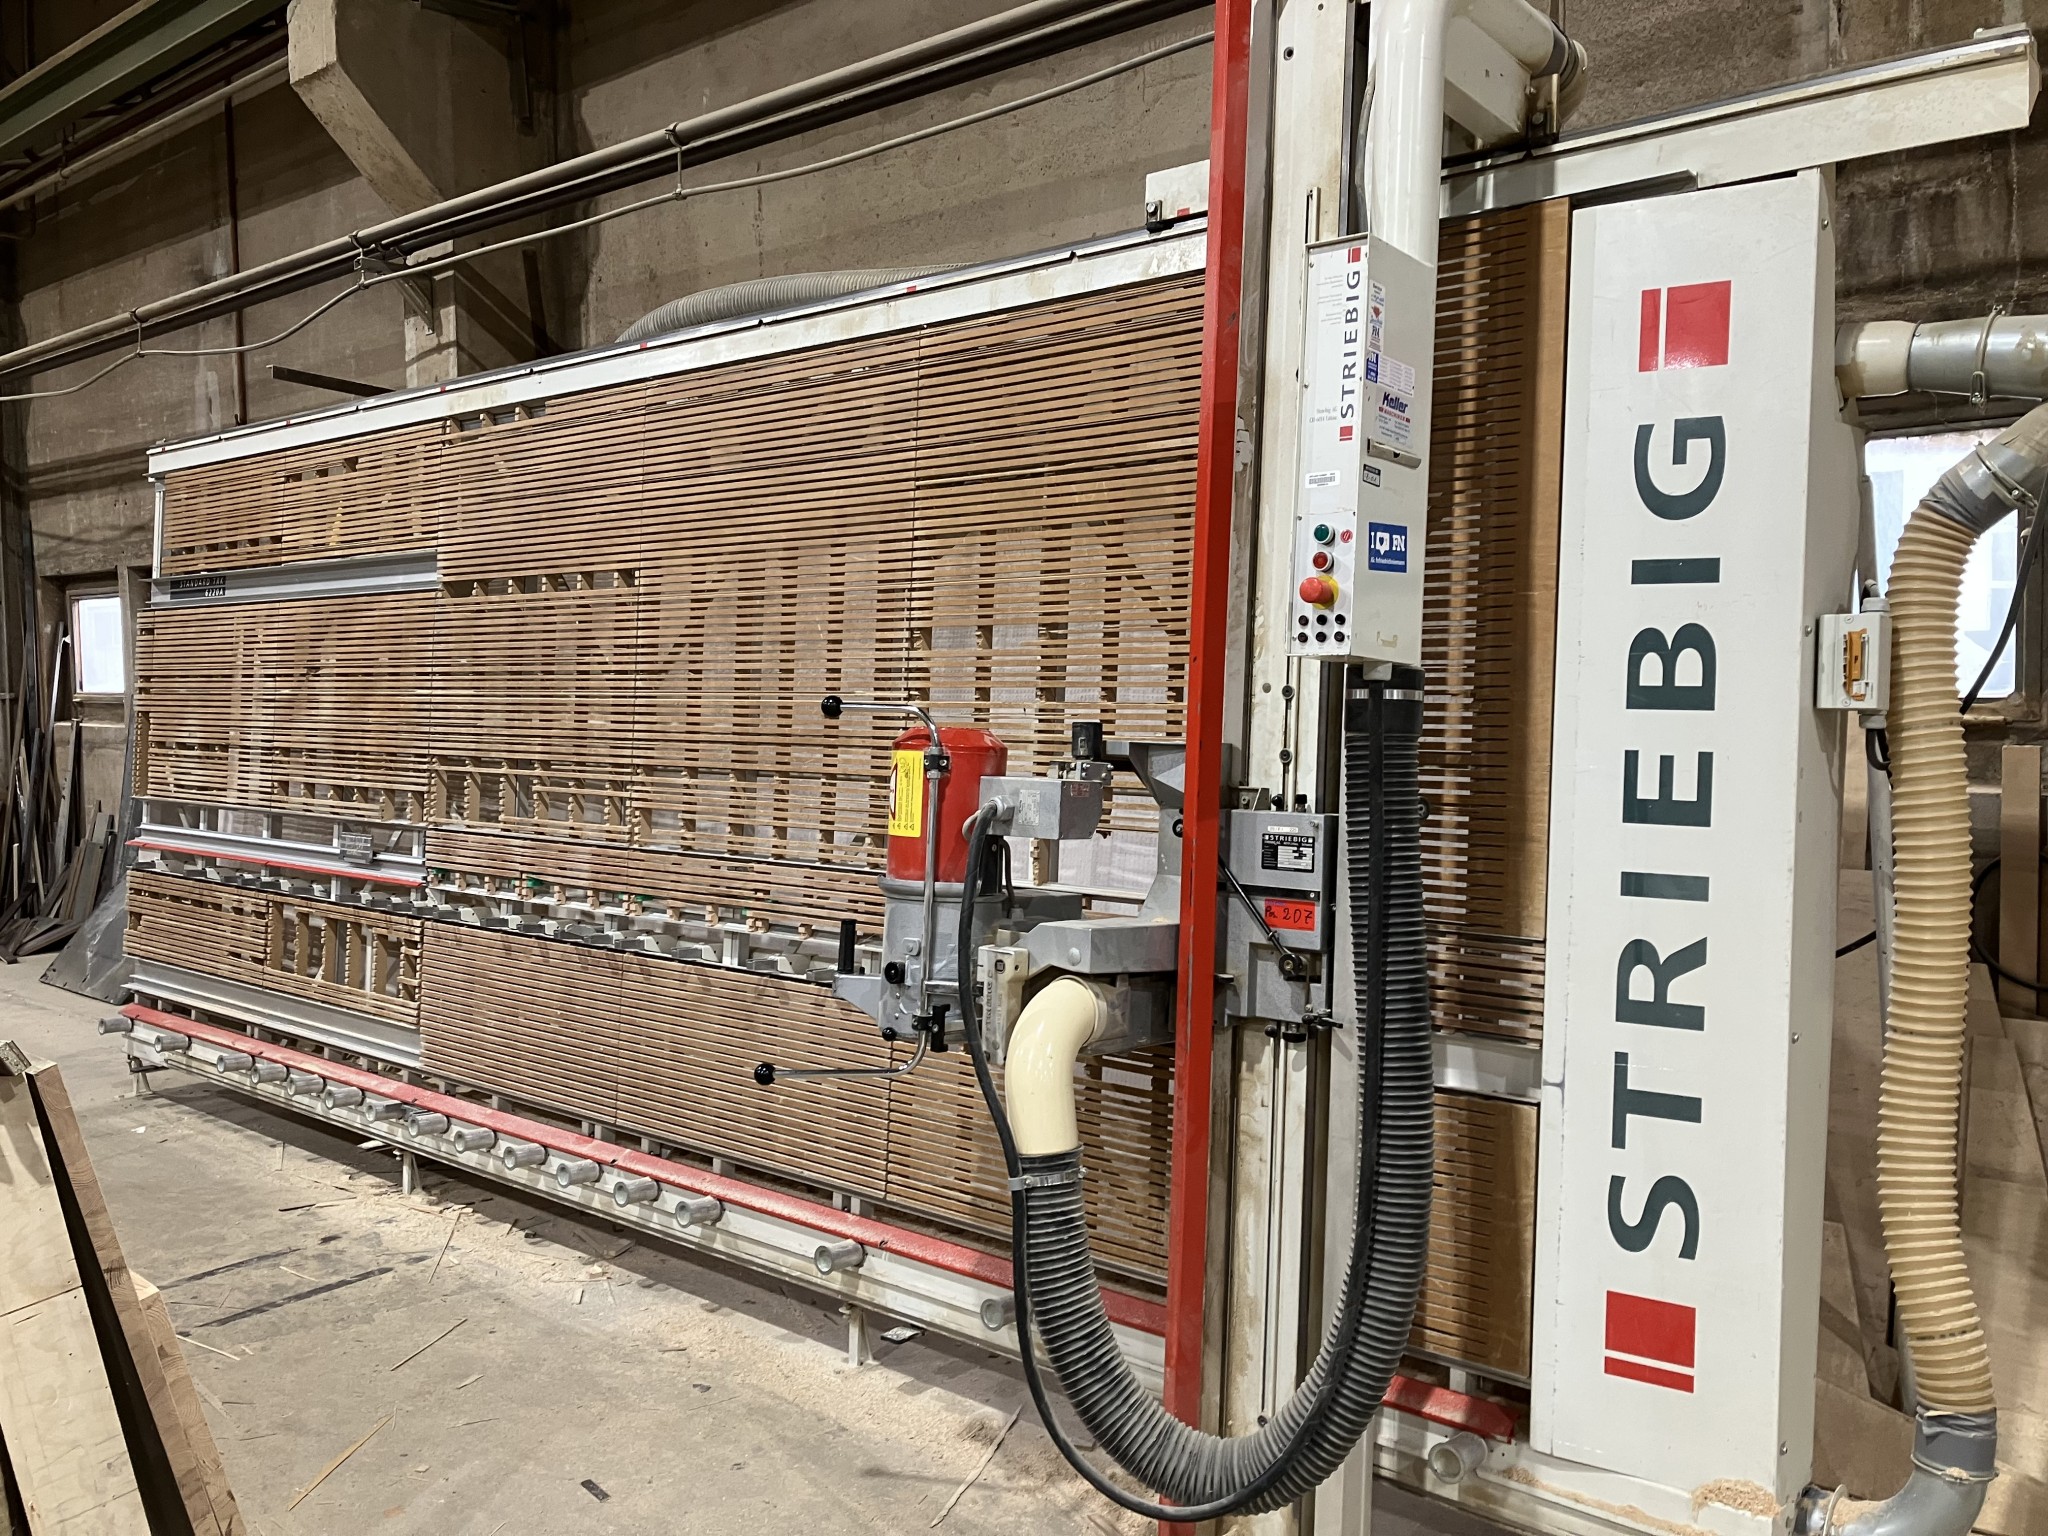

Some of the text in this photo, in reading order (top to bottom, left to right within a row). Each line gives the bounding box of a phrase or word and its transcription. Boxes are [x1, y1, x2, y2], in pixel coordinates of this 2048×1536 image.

[1340, 270, 1360, 419] STRIEBIG
[1382, 391, 1408, 414] Keller
[1392, 534, 1406, 552] FN
[180, 579, 210, 588] STANDARD
[1269, 834, 1308, 843] STRIEBIG
[1607, 415, 1726, 1261] STRIEBIG
[1282, 907, 1313, 925] 207
